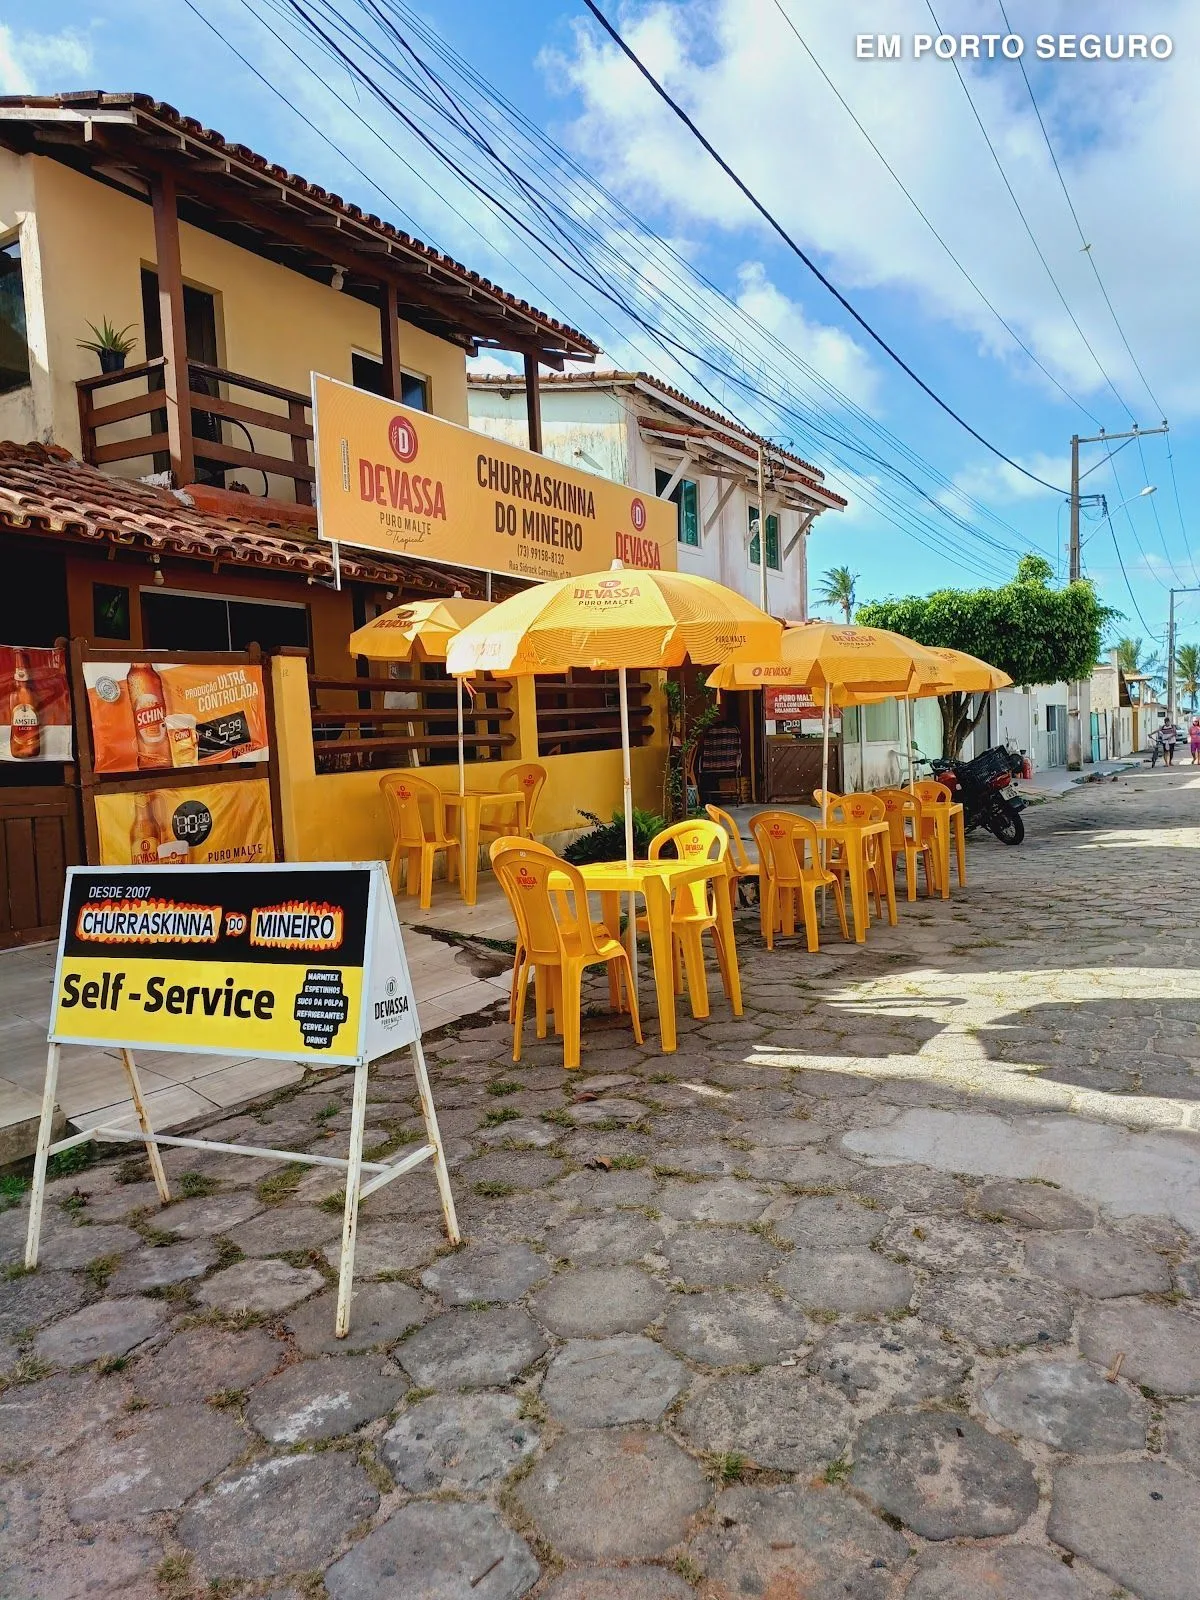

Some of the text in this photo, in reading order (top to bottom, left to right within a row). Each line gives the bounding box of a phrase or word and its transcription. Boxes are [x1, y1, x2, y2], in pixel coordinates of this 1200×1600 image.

[359, 458, 447, 521] DEVASSA
[477, 454, 596, 520] CHURRASKINNA
[379, 511, 432, 535] PURO MALTE
[495, 500, 583, 552] DO MINEIRO
[517, 543, 530, 559] (73)
[615, 531, 661, 570] DEVASSA
[508, 560, 519, 571] Rua
[574, 587, 641, 599] DEVASSA
[715, 635, 747, 643] PURO MALTE
[763, 667, 792, 676] DEVASSA
[185, 670, 248, 700] PRODUÇÃO ULTRA
[198, 682, 259, 713] CONTROLADA
[796, 693, 814, 702] MALT
[136, 707, 165, 727] SCHIN
[208, 844, 263, 862] PURO MALTE
[89, 886, 151, 899] DESDE 2007
[83, 912, 214, 936] CHURRASKINNA
[229, 914, 334, 939] DO MINEIRO
[307, 973, 339, 982] MARMITEX
[304, 985, 341, 994] ESPETINHOS
[297, 998, 312, 1006] SUCO
[323, 1000, 344, 1008] POLPA
[374, 995, 409, 1020] DEVASSA
[296, 1009, 345, 1020] REFRIGERANTES
[302, 1023, 334, 1032] CERVEJAS
[306, 1036, 328, 1045] DRINKS
